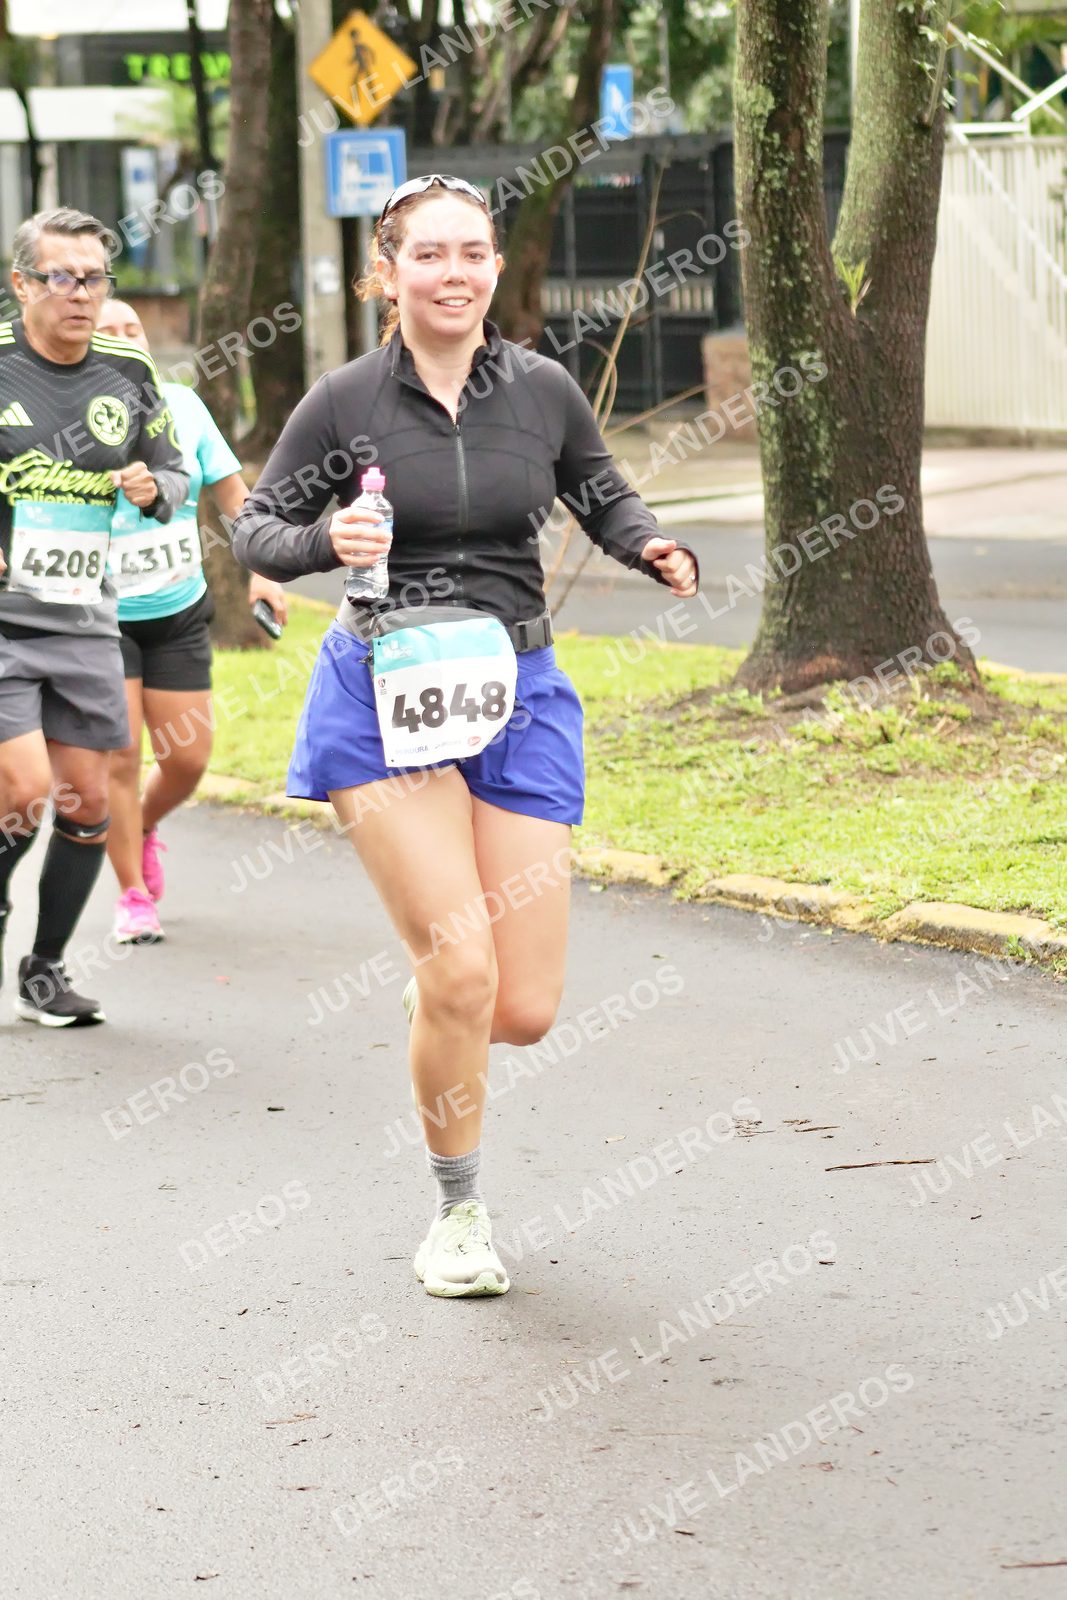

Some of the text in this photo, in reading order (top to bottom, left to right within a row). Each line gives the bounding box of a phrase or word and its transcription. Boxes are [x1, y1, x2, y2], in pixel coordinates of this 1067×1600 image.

[22, 547, 101, 579] 4208
[120, 537, 193, 575] 4315
[392, 681, 507, 734] 4848
